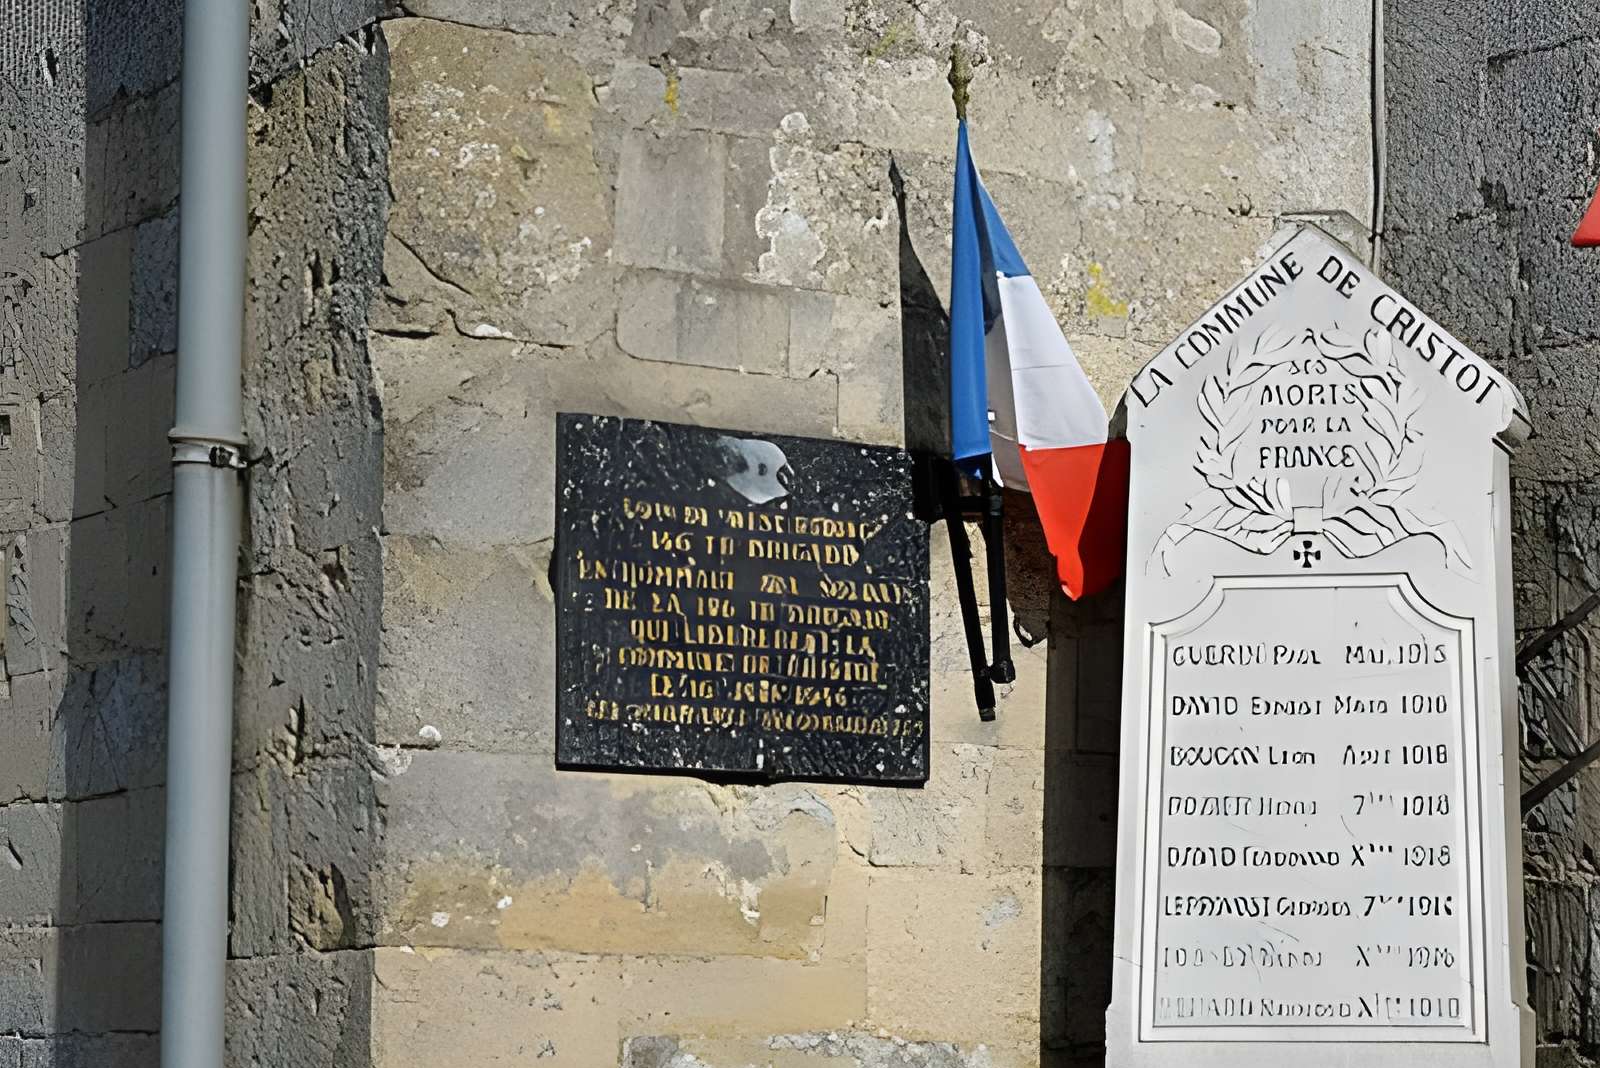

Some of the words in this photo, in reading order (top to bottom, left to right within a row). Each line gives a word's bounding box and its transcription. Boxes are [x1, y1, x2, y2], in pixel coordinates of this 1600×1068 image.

[1130, 368, 1173, 408] LA
[1174, 251, 1303, 369] COMMUNE
[1316, 255, 1361, 299] DE
[1370, 293, 1501, 404] CRISTOT
[1326, 416, 1351, 433] LA
[1259, 444, 1355, 469] FRANCE
[1172, 695, 1239, 716] DAVID
